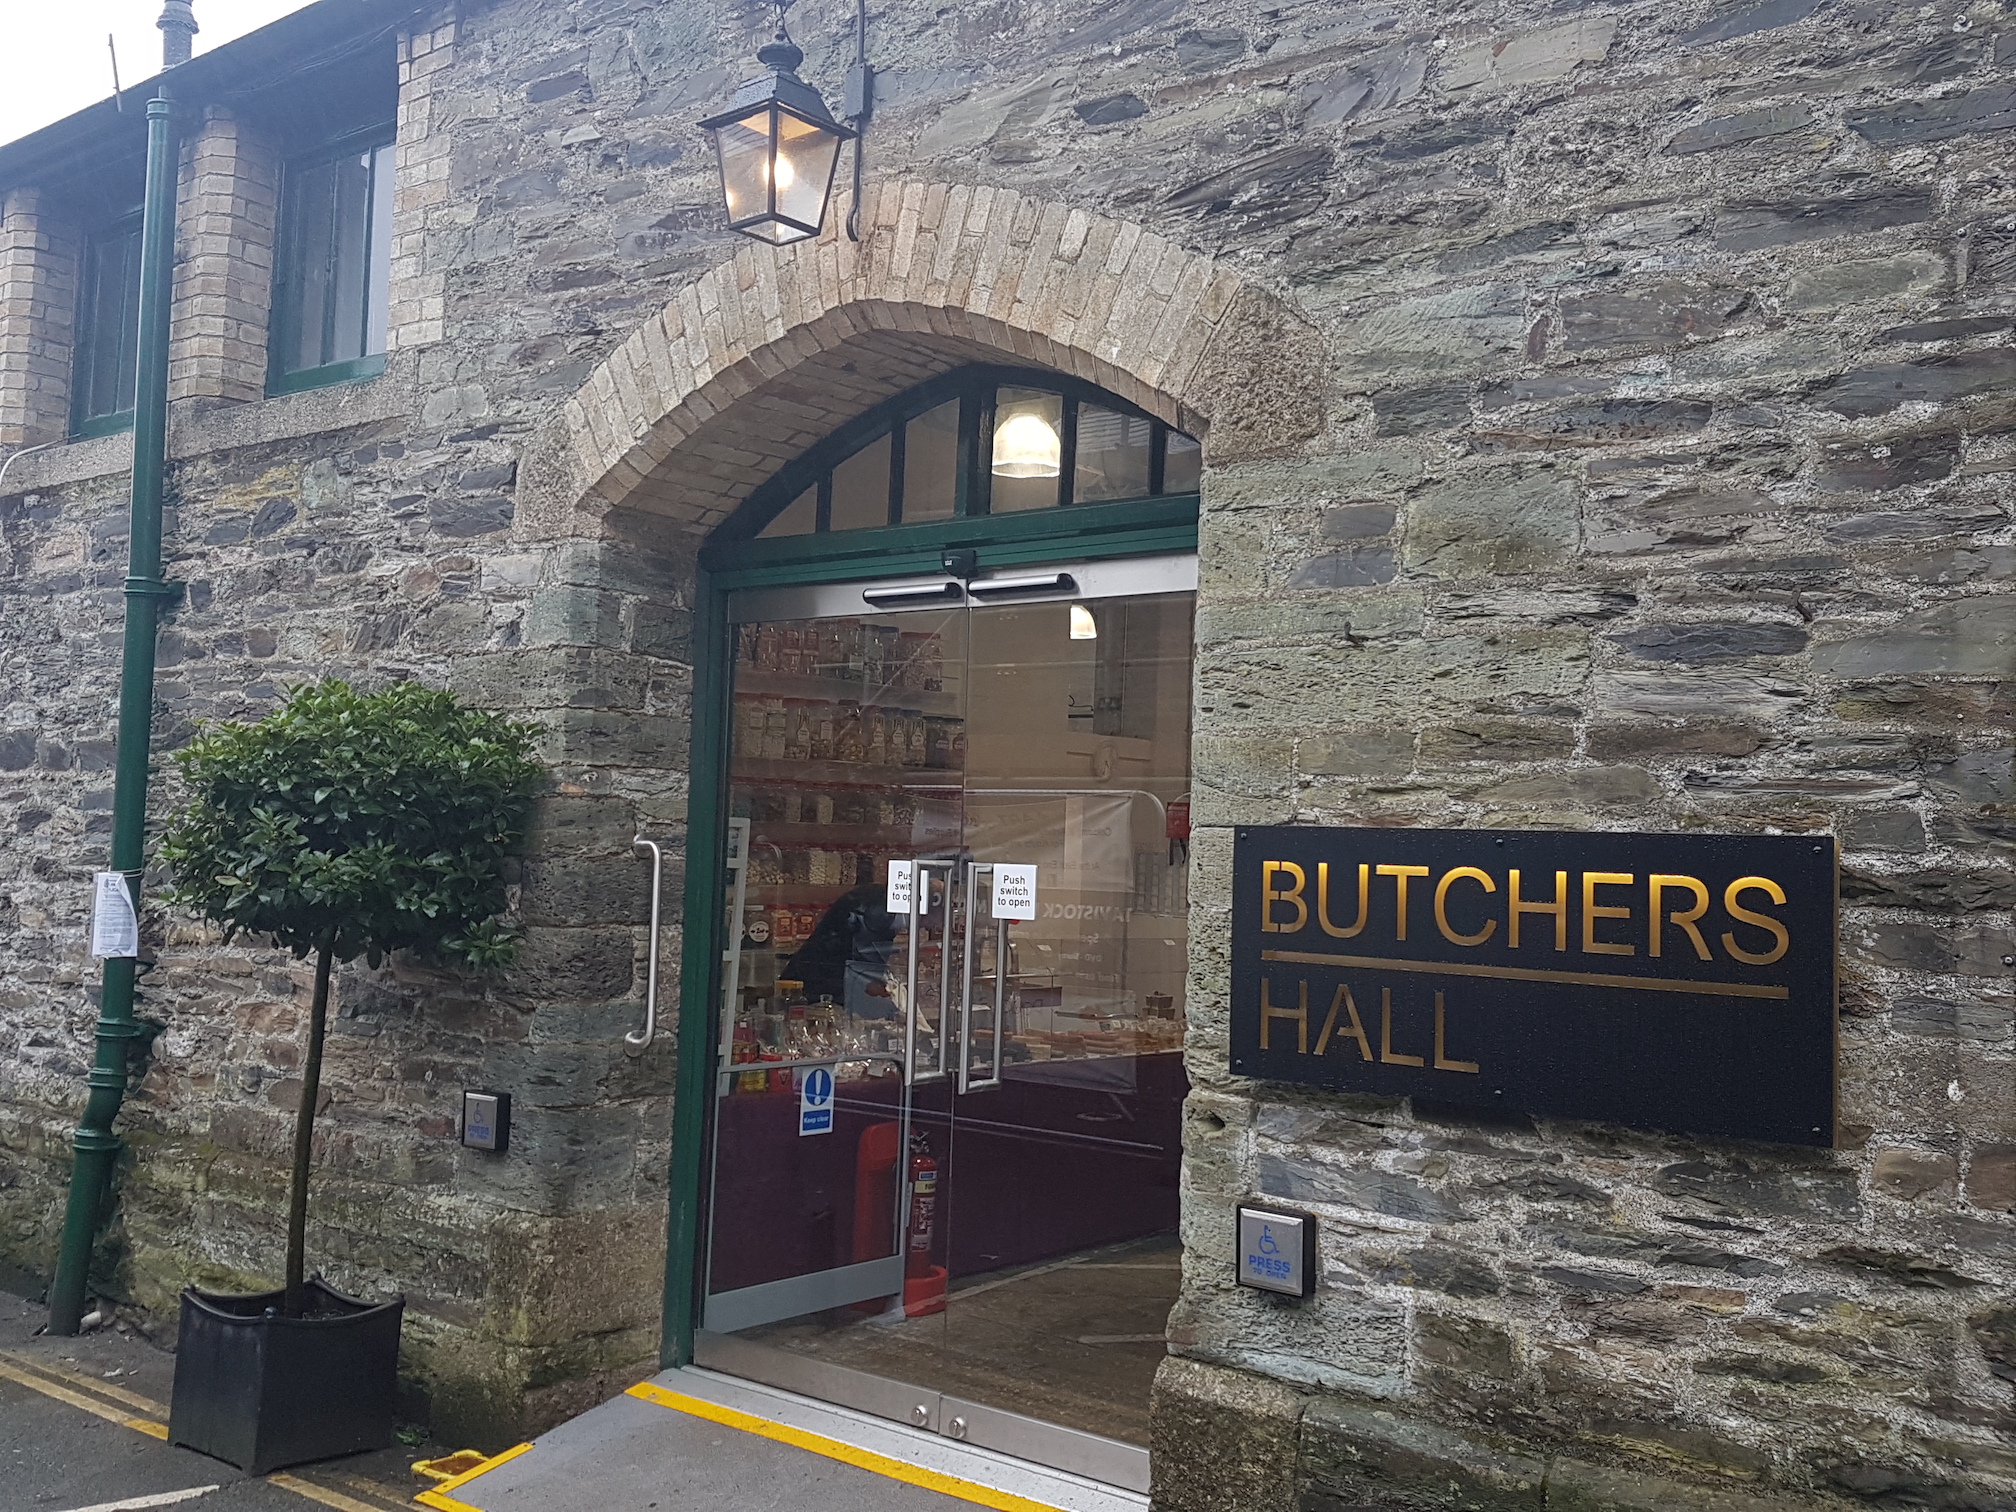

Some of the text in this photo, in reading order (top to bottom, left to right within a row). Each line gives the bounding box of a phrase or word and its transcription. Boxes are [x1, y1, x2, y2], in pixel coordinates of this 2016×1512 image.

[897, 870, 912, 880] Pus
[1003, 875, 1026, 885] Push
[894, 882, 912, 891] swit
[1000, 886, 1029, 896] switch
[892, 892, 901, 901] to
[997, 897, 1007, 906] to
[1008, 898, 1031, 908] open
[1261, 860, 1790, 966] BUTCHERS
[1259, 977, 1479, 1073] HALL
[1249, 1255, 1290, 1273] PRESS
[1253, 1267, 1286, 1279] TO OPEN
